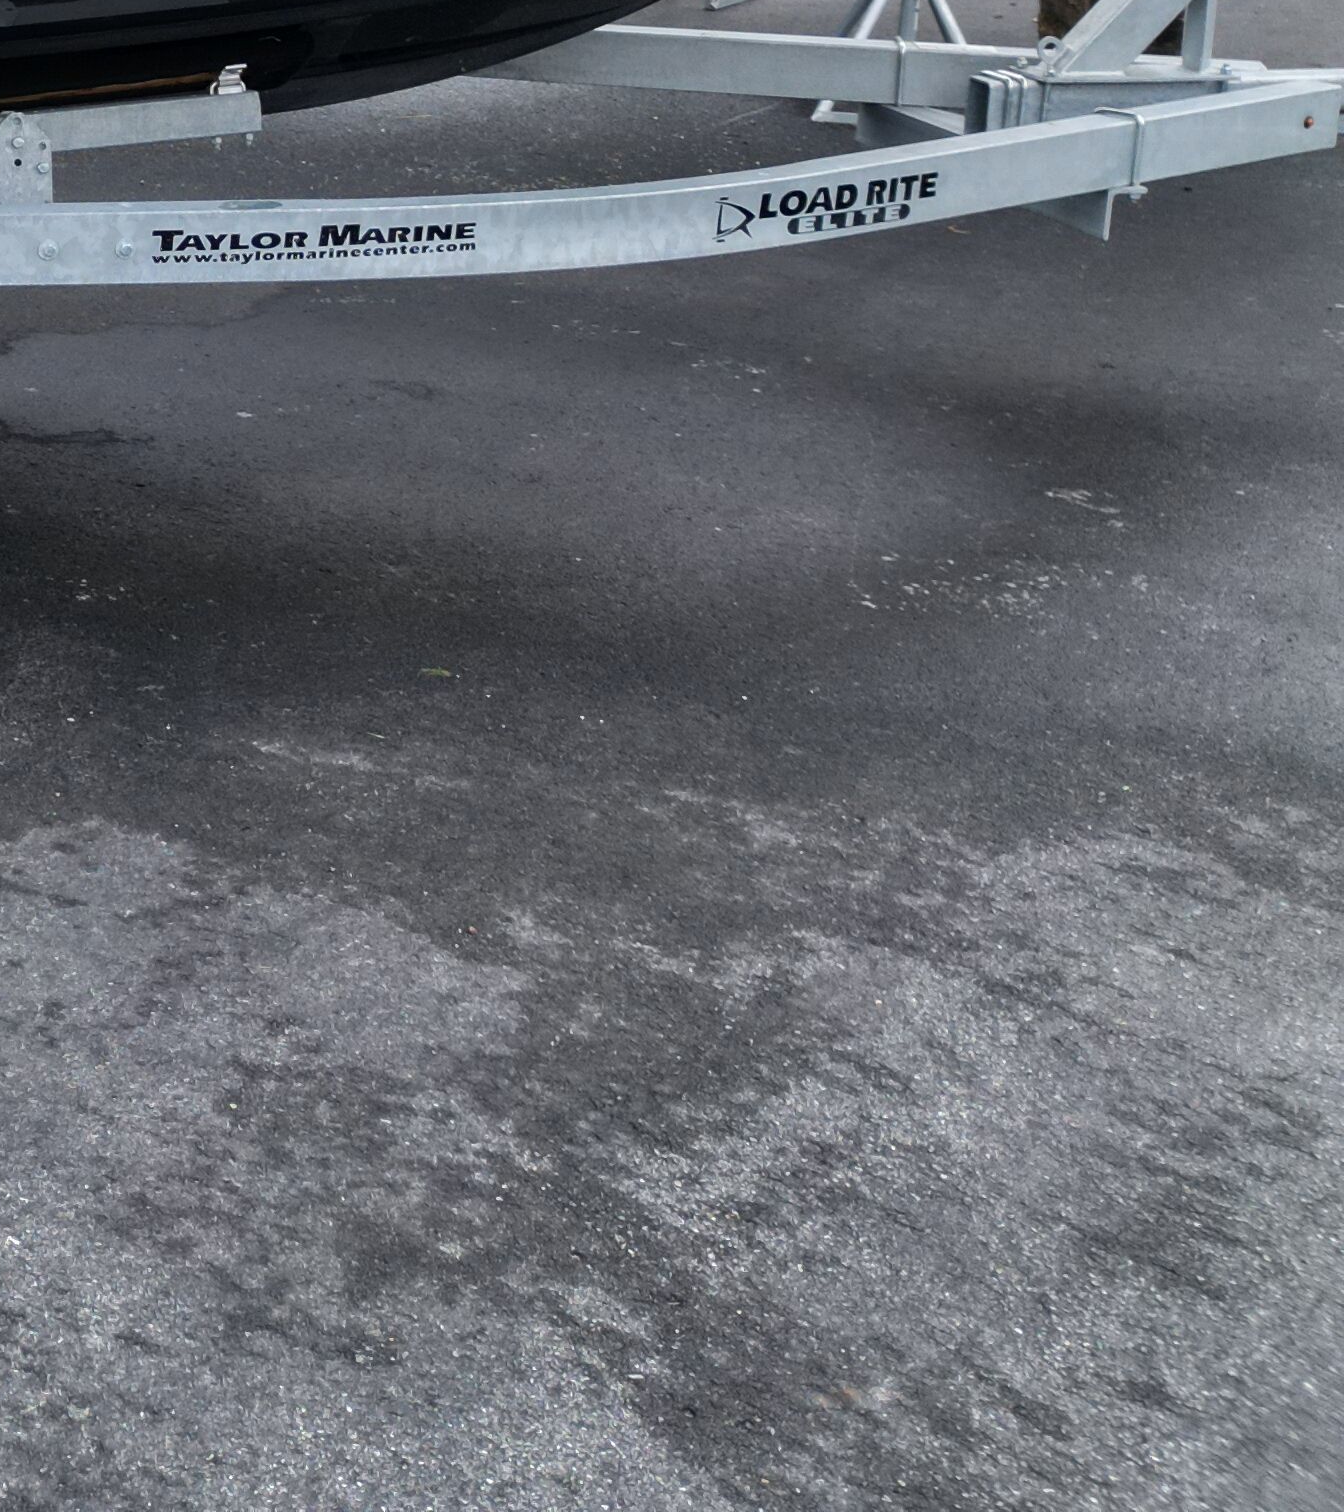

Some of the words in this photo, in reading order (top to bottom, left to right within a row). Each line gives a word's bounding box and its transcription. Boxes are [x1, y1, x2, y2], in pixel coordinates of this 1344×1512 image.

[758, 183, 858, 219] LOAD
[865, 172, 939, 206] RITE
[796, 205, 903, 234] ELITE
[151, 229, 309, 252] TAYLOR
[318, 222, 477, 247] MARINE
[151, 241, 477, 265] www.taylormarinecenter.com
